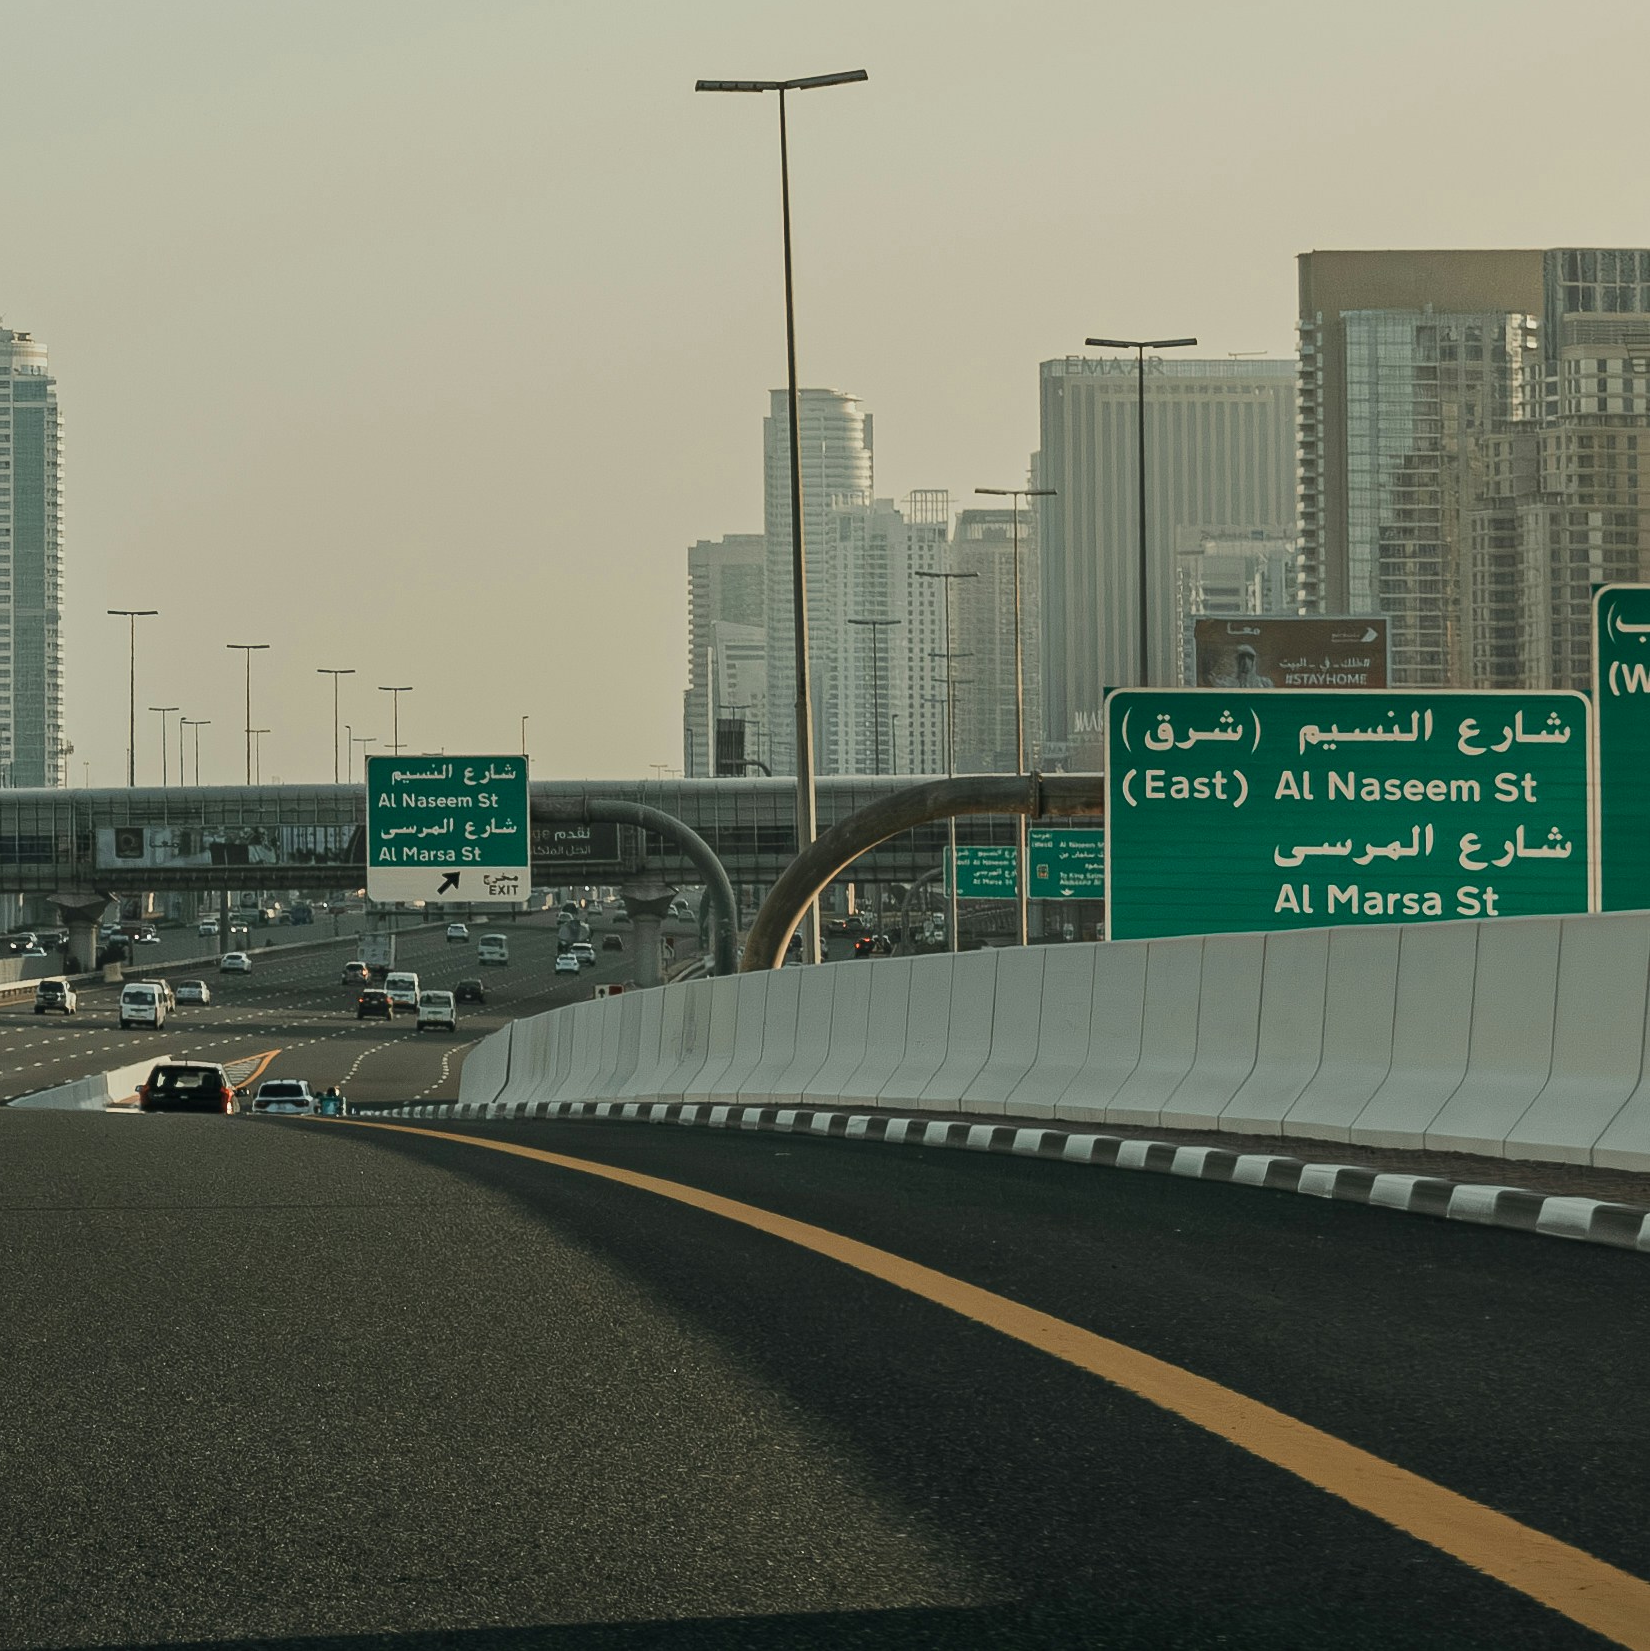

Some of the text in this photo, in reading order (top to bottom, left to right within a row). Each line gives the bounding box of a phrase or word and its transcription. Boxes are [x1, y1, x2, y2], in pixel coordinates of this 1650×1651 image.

[1065, 355, 1165, 376] EMAAR
[1285, 673, 1368, 685] #STAYHOME
[1300, 709, 1432, 754] النسيم
[1458, 711, 1570, 755] شارع
[391, 763, 516, 785] شارع النسيم
[1123, 769, 1536, 807] (East) Al Naseem St
[378, 792, 499, 808] Al Naseem St
[381, 818, 454, 839] المرسى
[464, 818, 517, 839] شارع
[378, 846, 481, 861] Al Marsa St
[1274, 824, 1571, 870] شارع المرسى
[483, 873, 519, 885] مخرج
[488, 884, 519, 896] EXIT
[1275, 884, 1499, 916] Al Marsa St
